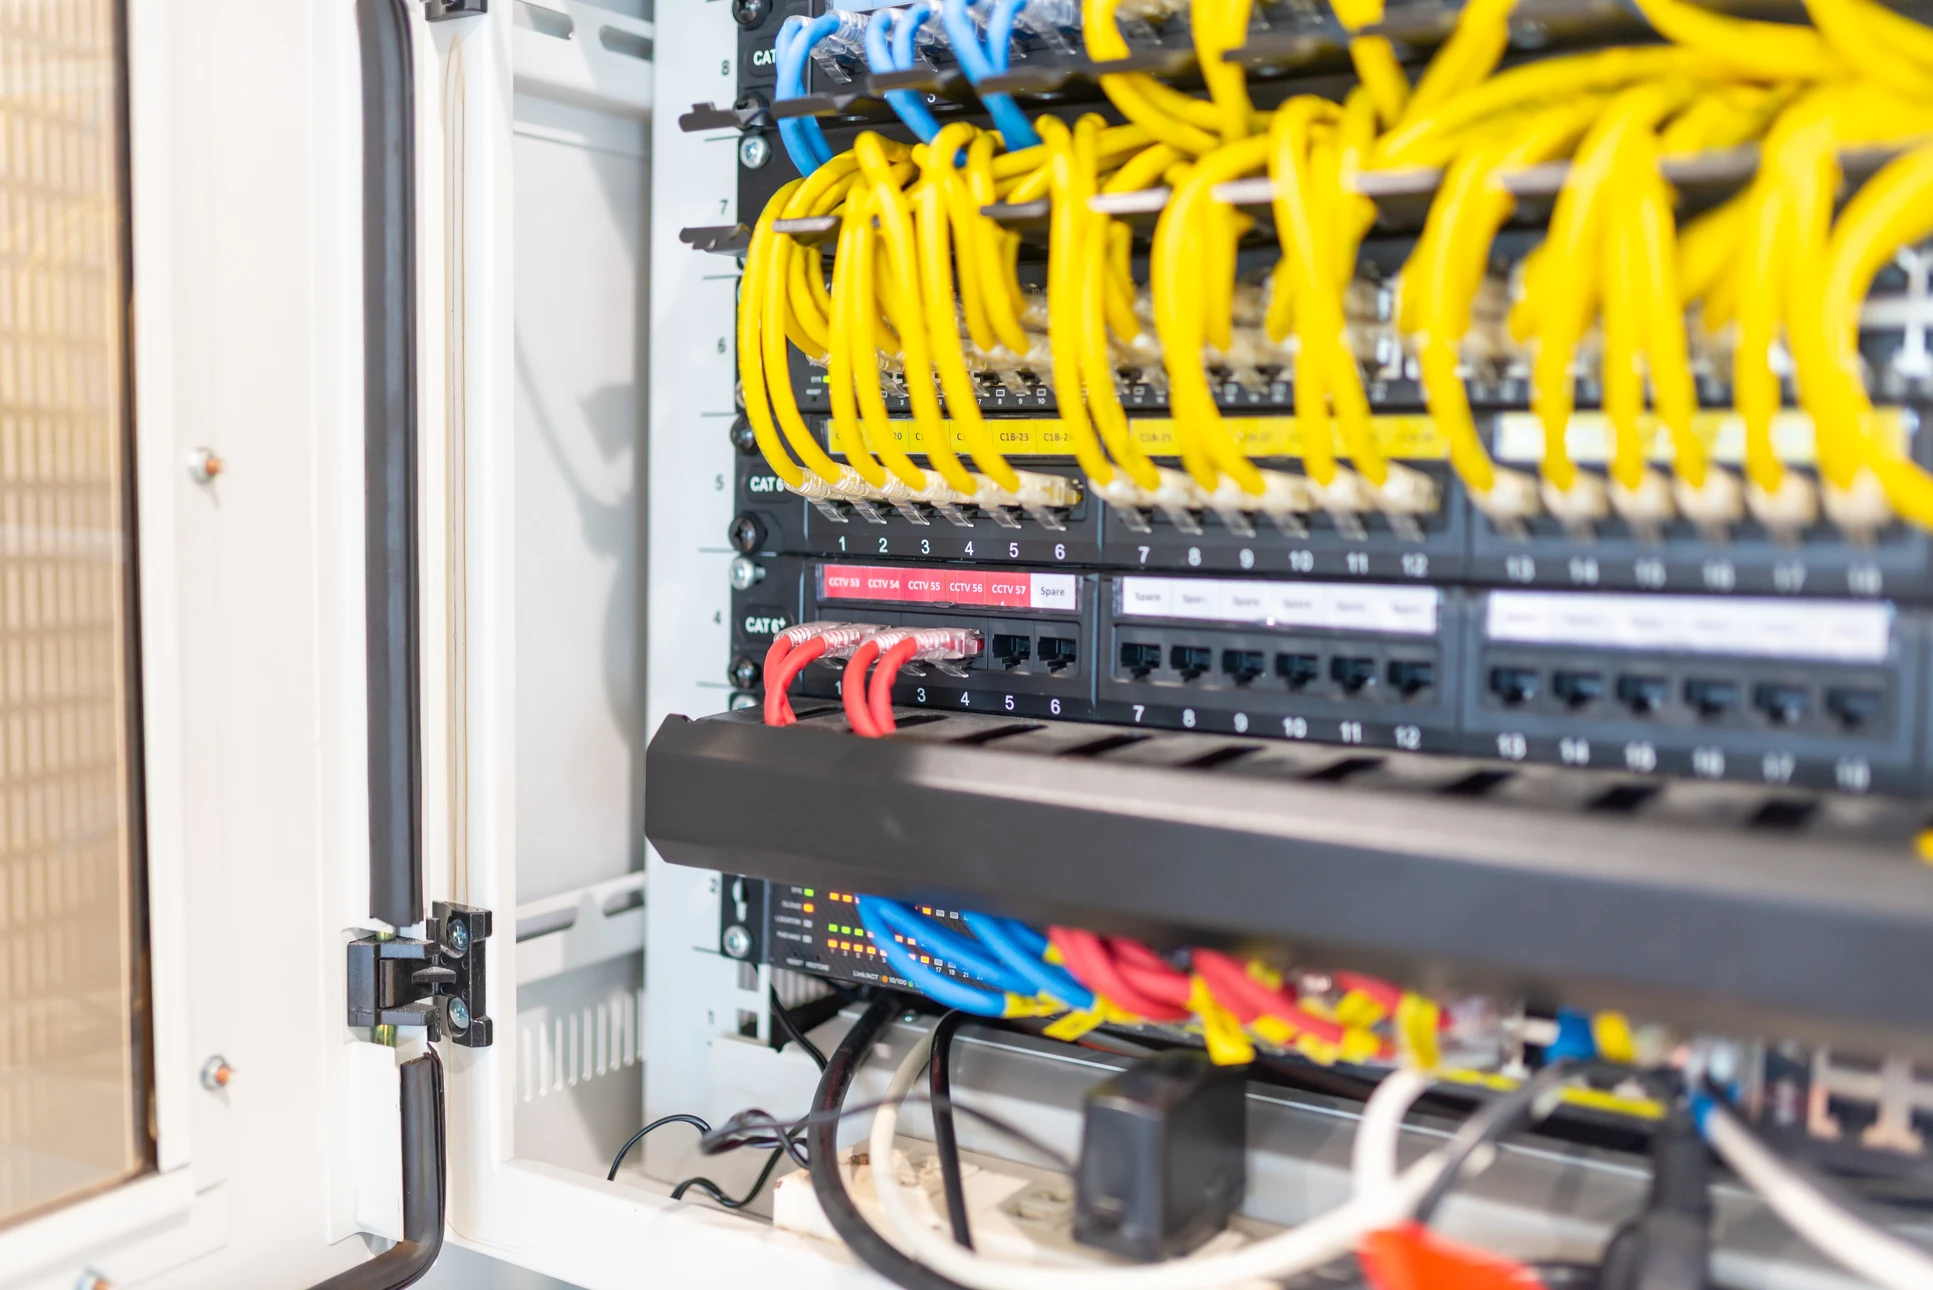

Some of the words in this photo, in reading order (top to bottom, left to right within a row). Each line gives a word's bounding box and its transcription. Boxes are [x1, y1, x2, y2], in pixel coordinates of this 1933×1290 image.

[753, 50, 776, 66] CAT
[721, 60, 730, 76] 8
[720, 199, 729, 215] 7
[717, 338, 726, 354] 6
[999, 432, 1029, 442] C1B-23
[715, 477, 724, 491] 5
[750, 476, 775, 493] CAT
[838, 536, 847, 552] 1
[878, 537, 888, 553] 2
[920, 539, 931, 555] 3
[964, 540, 975, 556] 4
[1008, 542, 1020, 558] 5
[1054, 543, 1066, 560] 6
[1138, 546, 1151, 564] 7
[1187, 546, 1202, 567] 8
[1239, 547, 1255, 569] 9
[1288, 549, 1314, 573] 10
[1345, 551, 1369, 575] 11
[1401, 552, 1428, 578] 12
[829, 576, 849, 587] CCTV
[850, 577, 860, 588] 53
[867, 579, 888, 589] CCTV
[889, 580, 900, 590] 54
[908, 580, 929, 590] CCTV
[931, 581, 941, 591] 55
[949, 582, 971, 592] CCTV
[972, 583, 983, 593] 56
[992, 584, 1014, 594] CCTV
[1015, 585, 1026, 595] 57
[1040, 586, 1065, 597] Spare
[713, 611, 722, 625] 4
[745, 616, 771, 634] CAT
[917, 688, 926, 704] 3
[960, 691, 970, 707] 4
[1004, 695, 1015, 711] 5
[1050, 698, 1061, 715] 6
[1132, 704, 1145, 722] 7
[1182, 708, 1196, 728] 8
[1233, 712, 1249, 733] 9
[1282, 716, 1307, 740] 10
[1339, 720, 1362, 744] 11
[1393, 725, 1421, 750] 12
